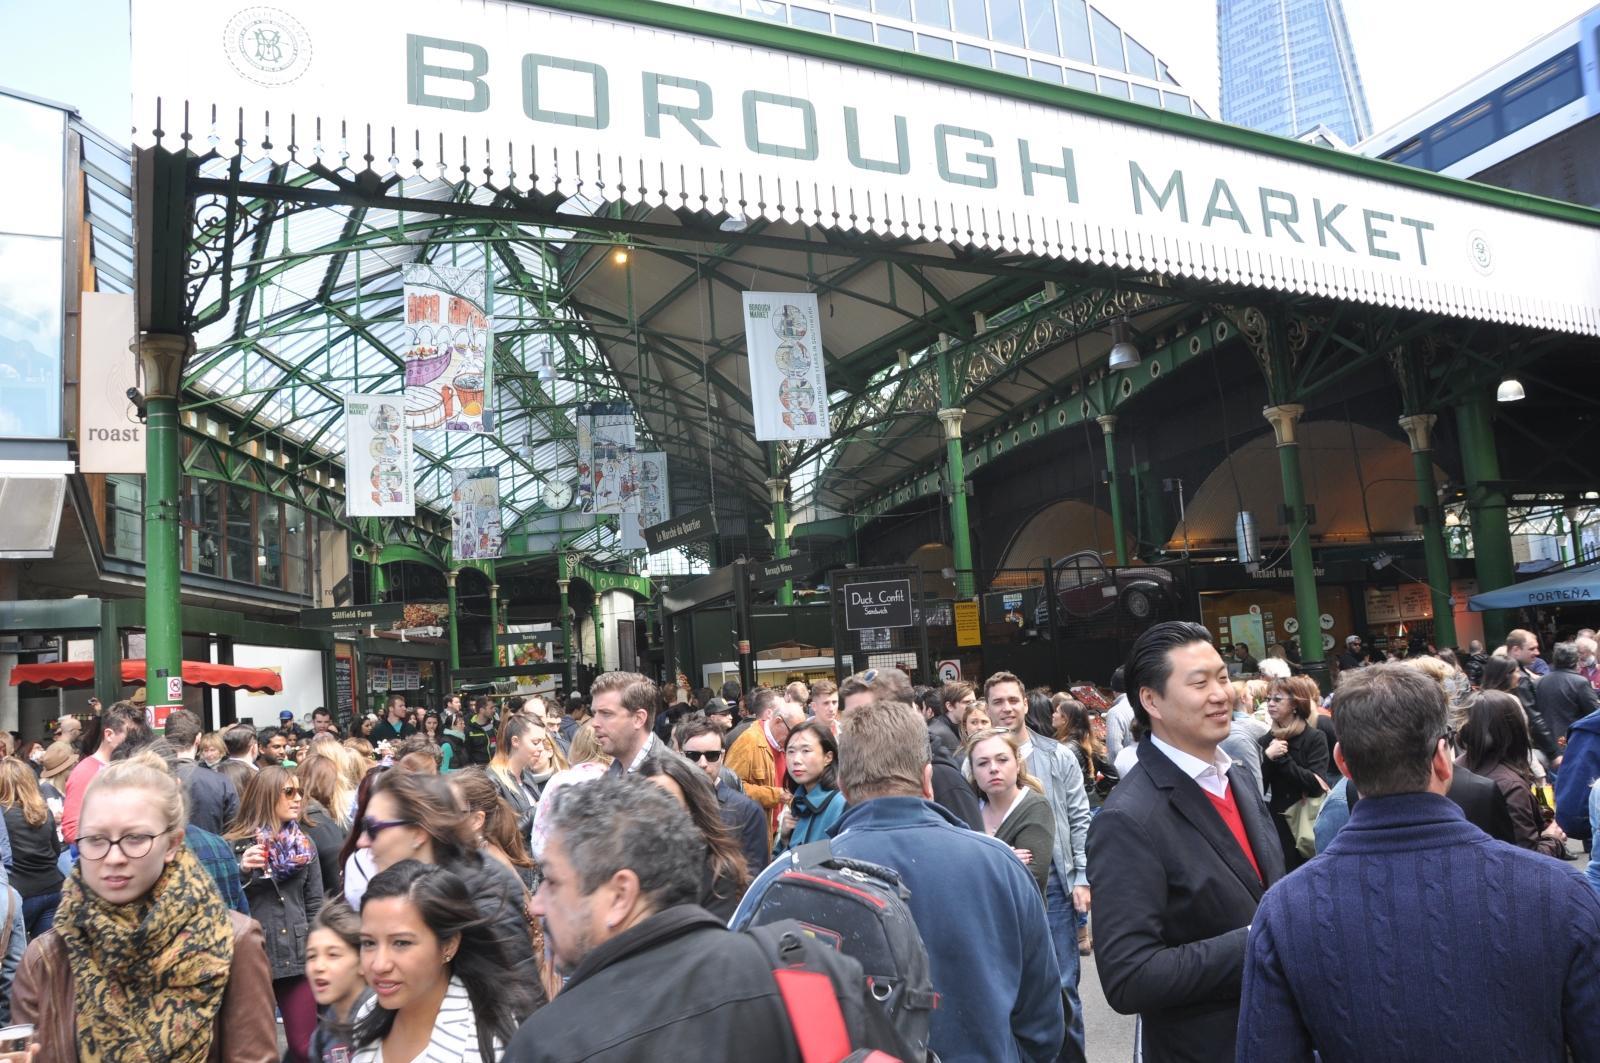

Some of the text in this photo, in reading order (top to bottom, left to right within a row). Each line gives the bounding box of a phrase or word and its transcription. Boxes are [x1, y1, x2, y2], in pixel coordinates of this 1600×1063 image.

[407, 33, 1434, 266] BOROUGH MARKET
[816, 386, 825, 427] CELEBRATING
[88, 427, 140, 442] roast
[656, 532, 662, 542] Le
[682, 518, 701, 534] Quartier
[1252, 568, 1277, 579] Richard
[852, 589, 905, 605] Duck Confit
[1528, 587, 1591, 603] PORTEÑA
[331, 609, 373, 620] Sillfield Farm
[864, 606, 888, 616] Sandwich
[945, 669, 953, 681] 5
